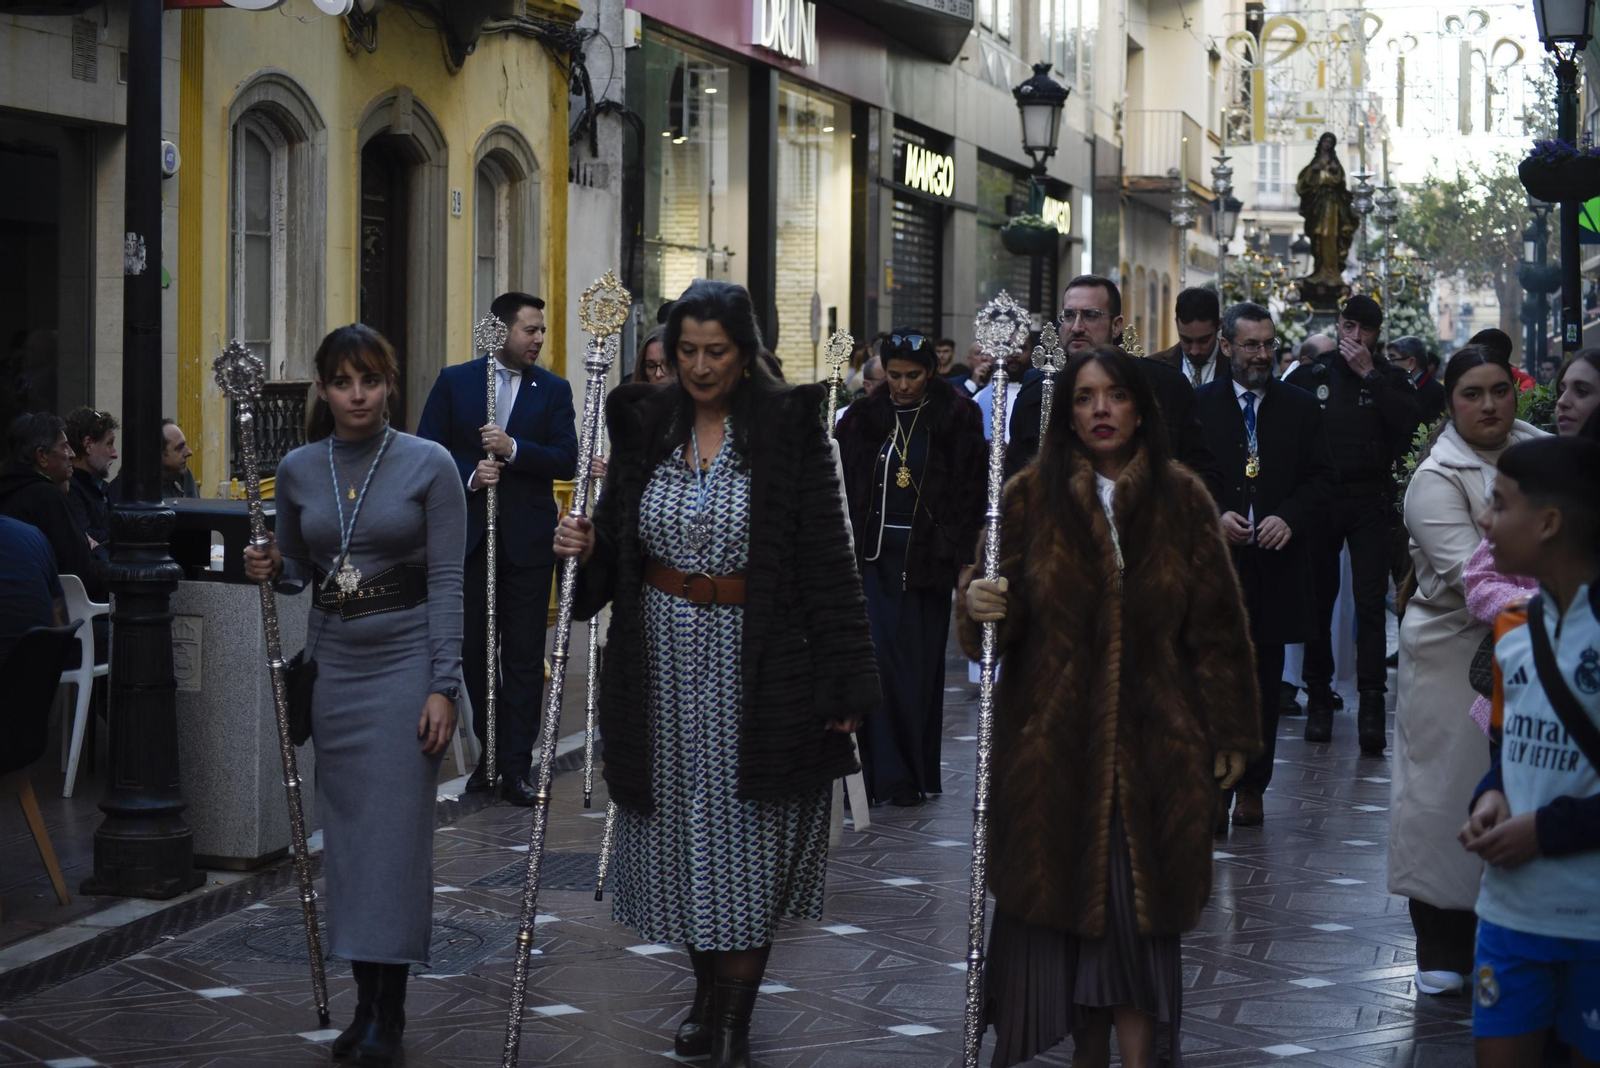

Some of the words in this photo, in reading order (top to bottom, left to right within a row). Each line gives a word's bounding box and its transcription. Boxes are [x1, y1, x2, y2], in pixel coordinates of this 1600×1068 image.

[760, 0, 816, 66] DRUNI
[905, 143, 954, 197] MANGO
[453, 190, 461, 212] 39
